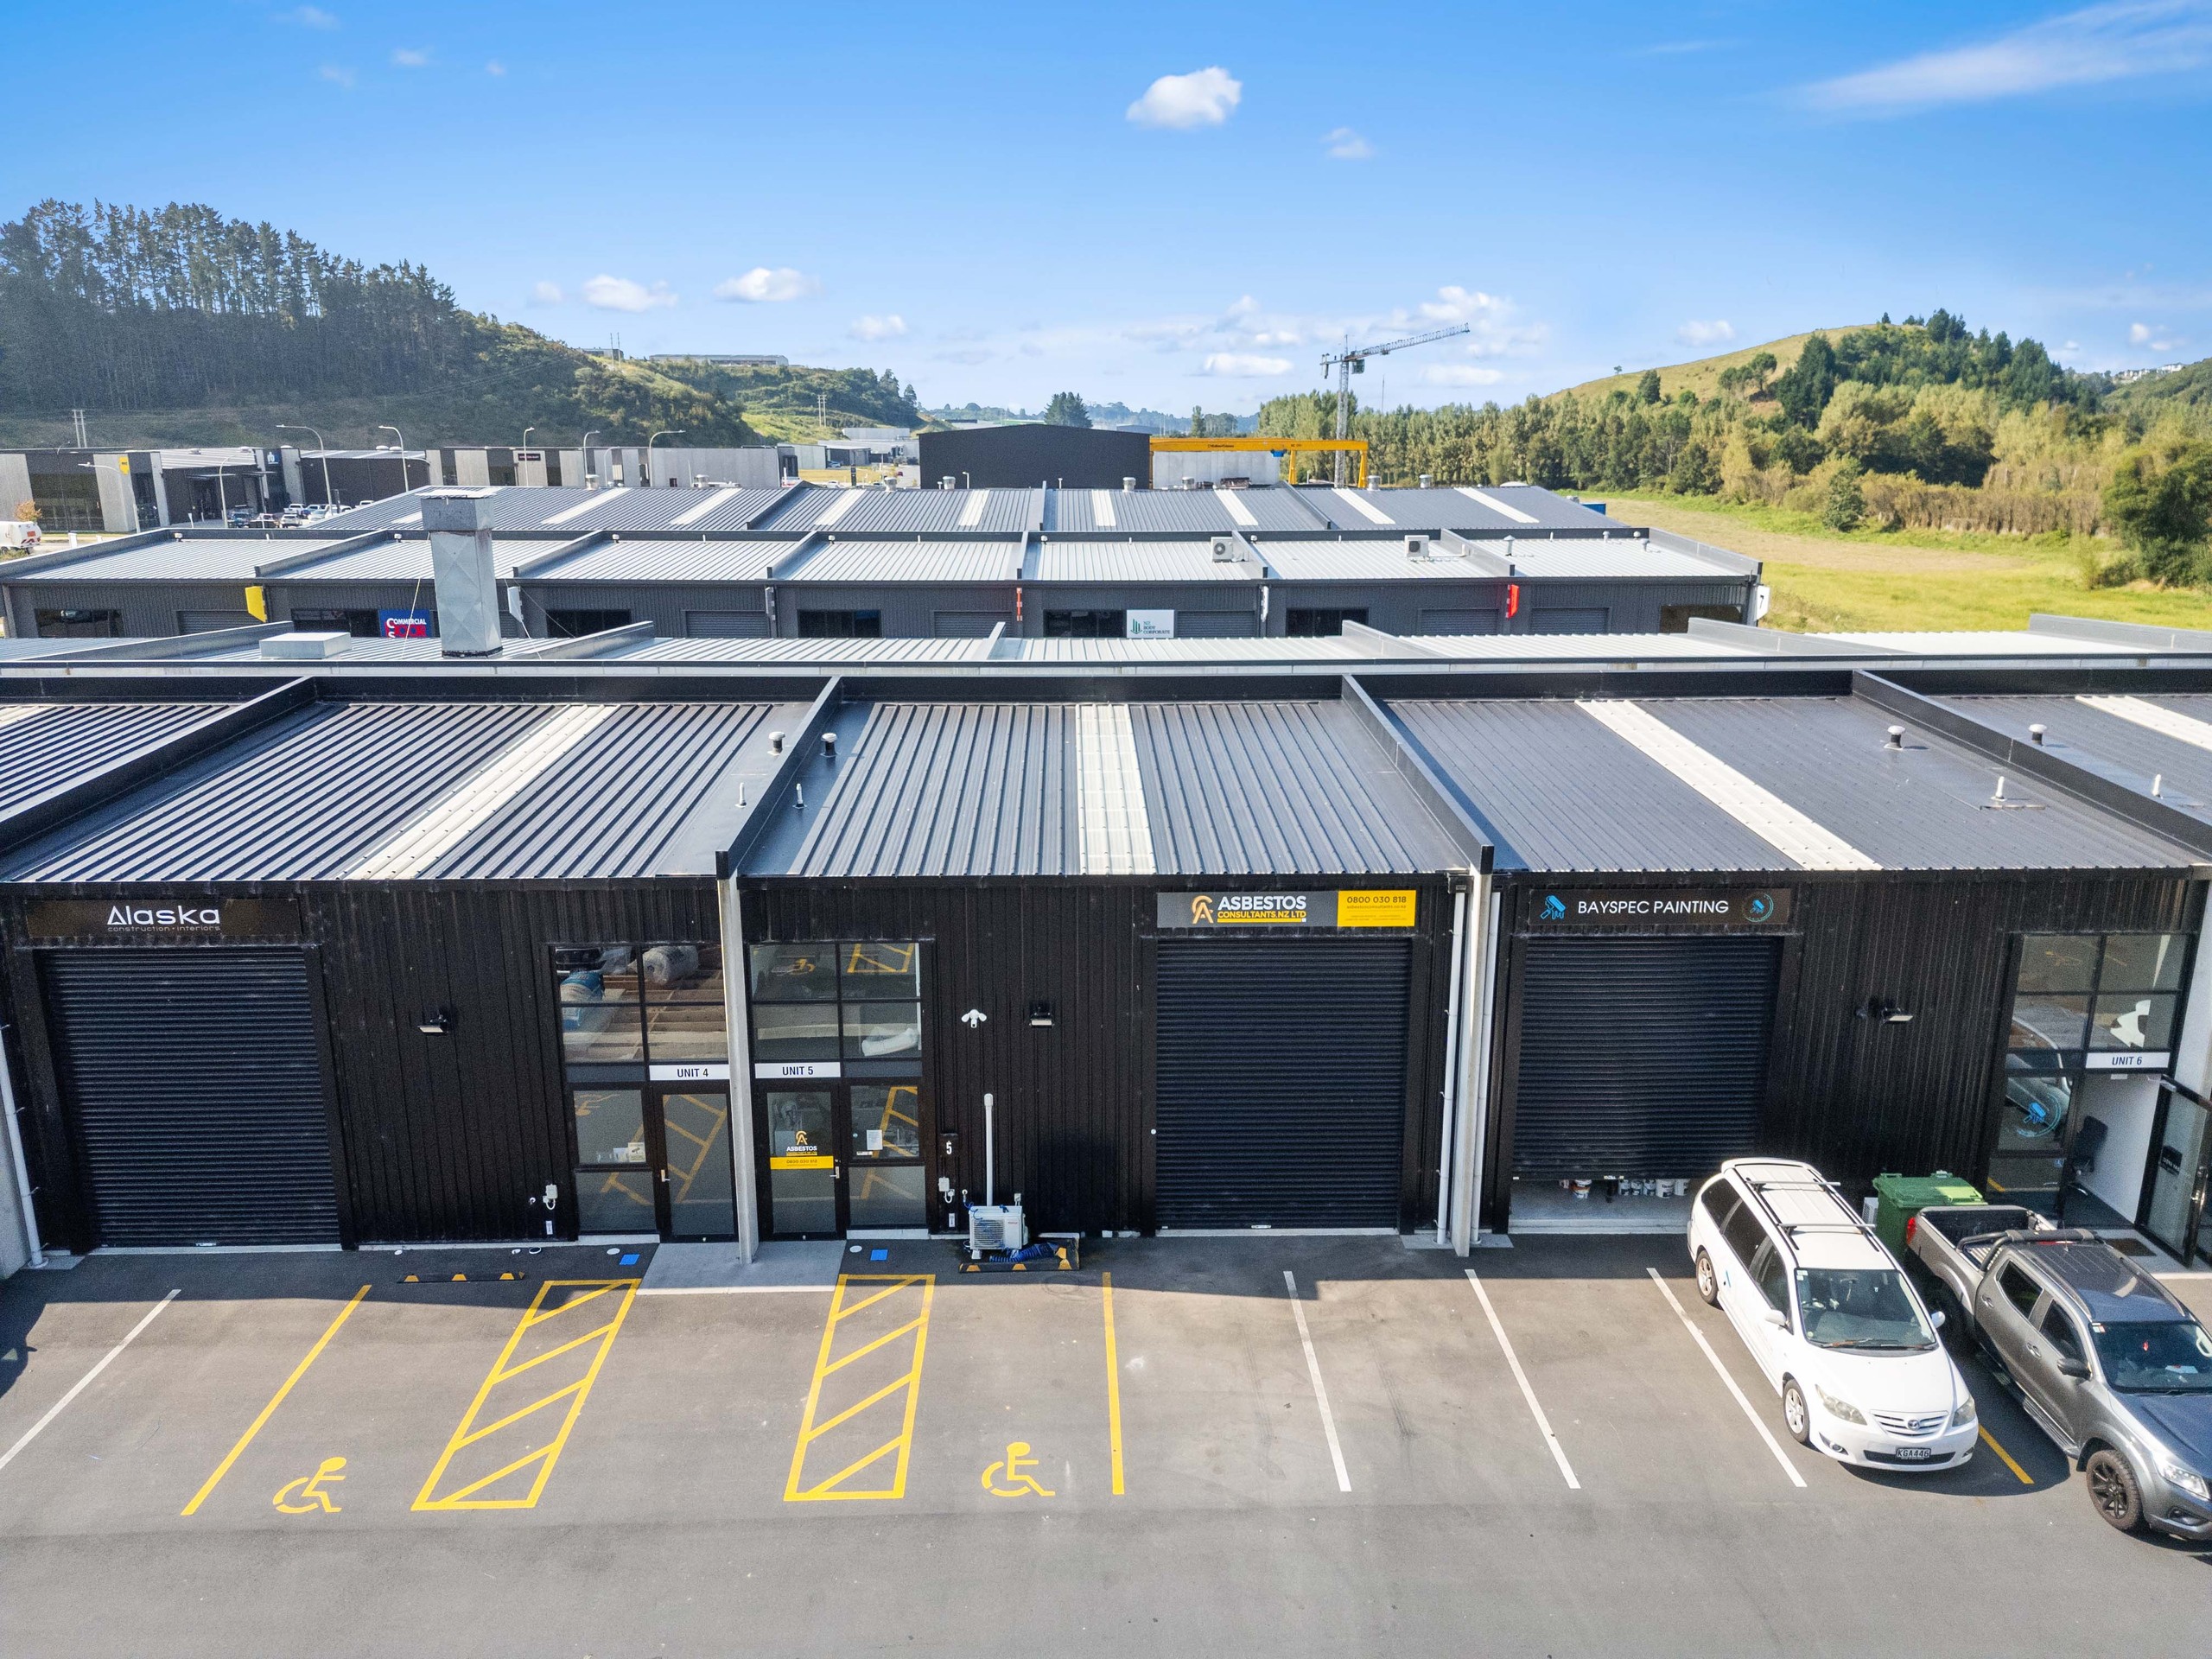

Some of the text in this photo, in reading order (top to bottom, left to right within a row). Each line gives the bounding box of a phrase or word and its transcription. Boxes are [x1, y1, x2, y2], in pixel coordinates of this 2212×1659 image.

[386, 618, 427, 628] COMMERCIAL
[1217, 895, 1306, 910] ASBESTOS
[1578, 900, 1729, 914] BAYSPEC PAINTING
[107, 905, 220, 925] Alaska
[1291, 910, 1306, 918] LTD
[2112, 1056, 2142, 1065] UNIT 6
[677, 1068, 709, 1077] UNIT 4
[782, 1066, 814, 1076] UNIT 5
[946, 1141, 952, 1154] 5
